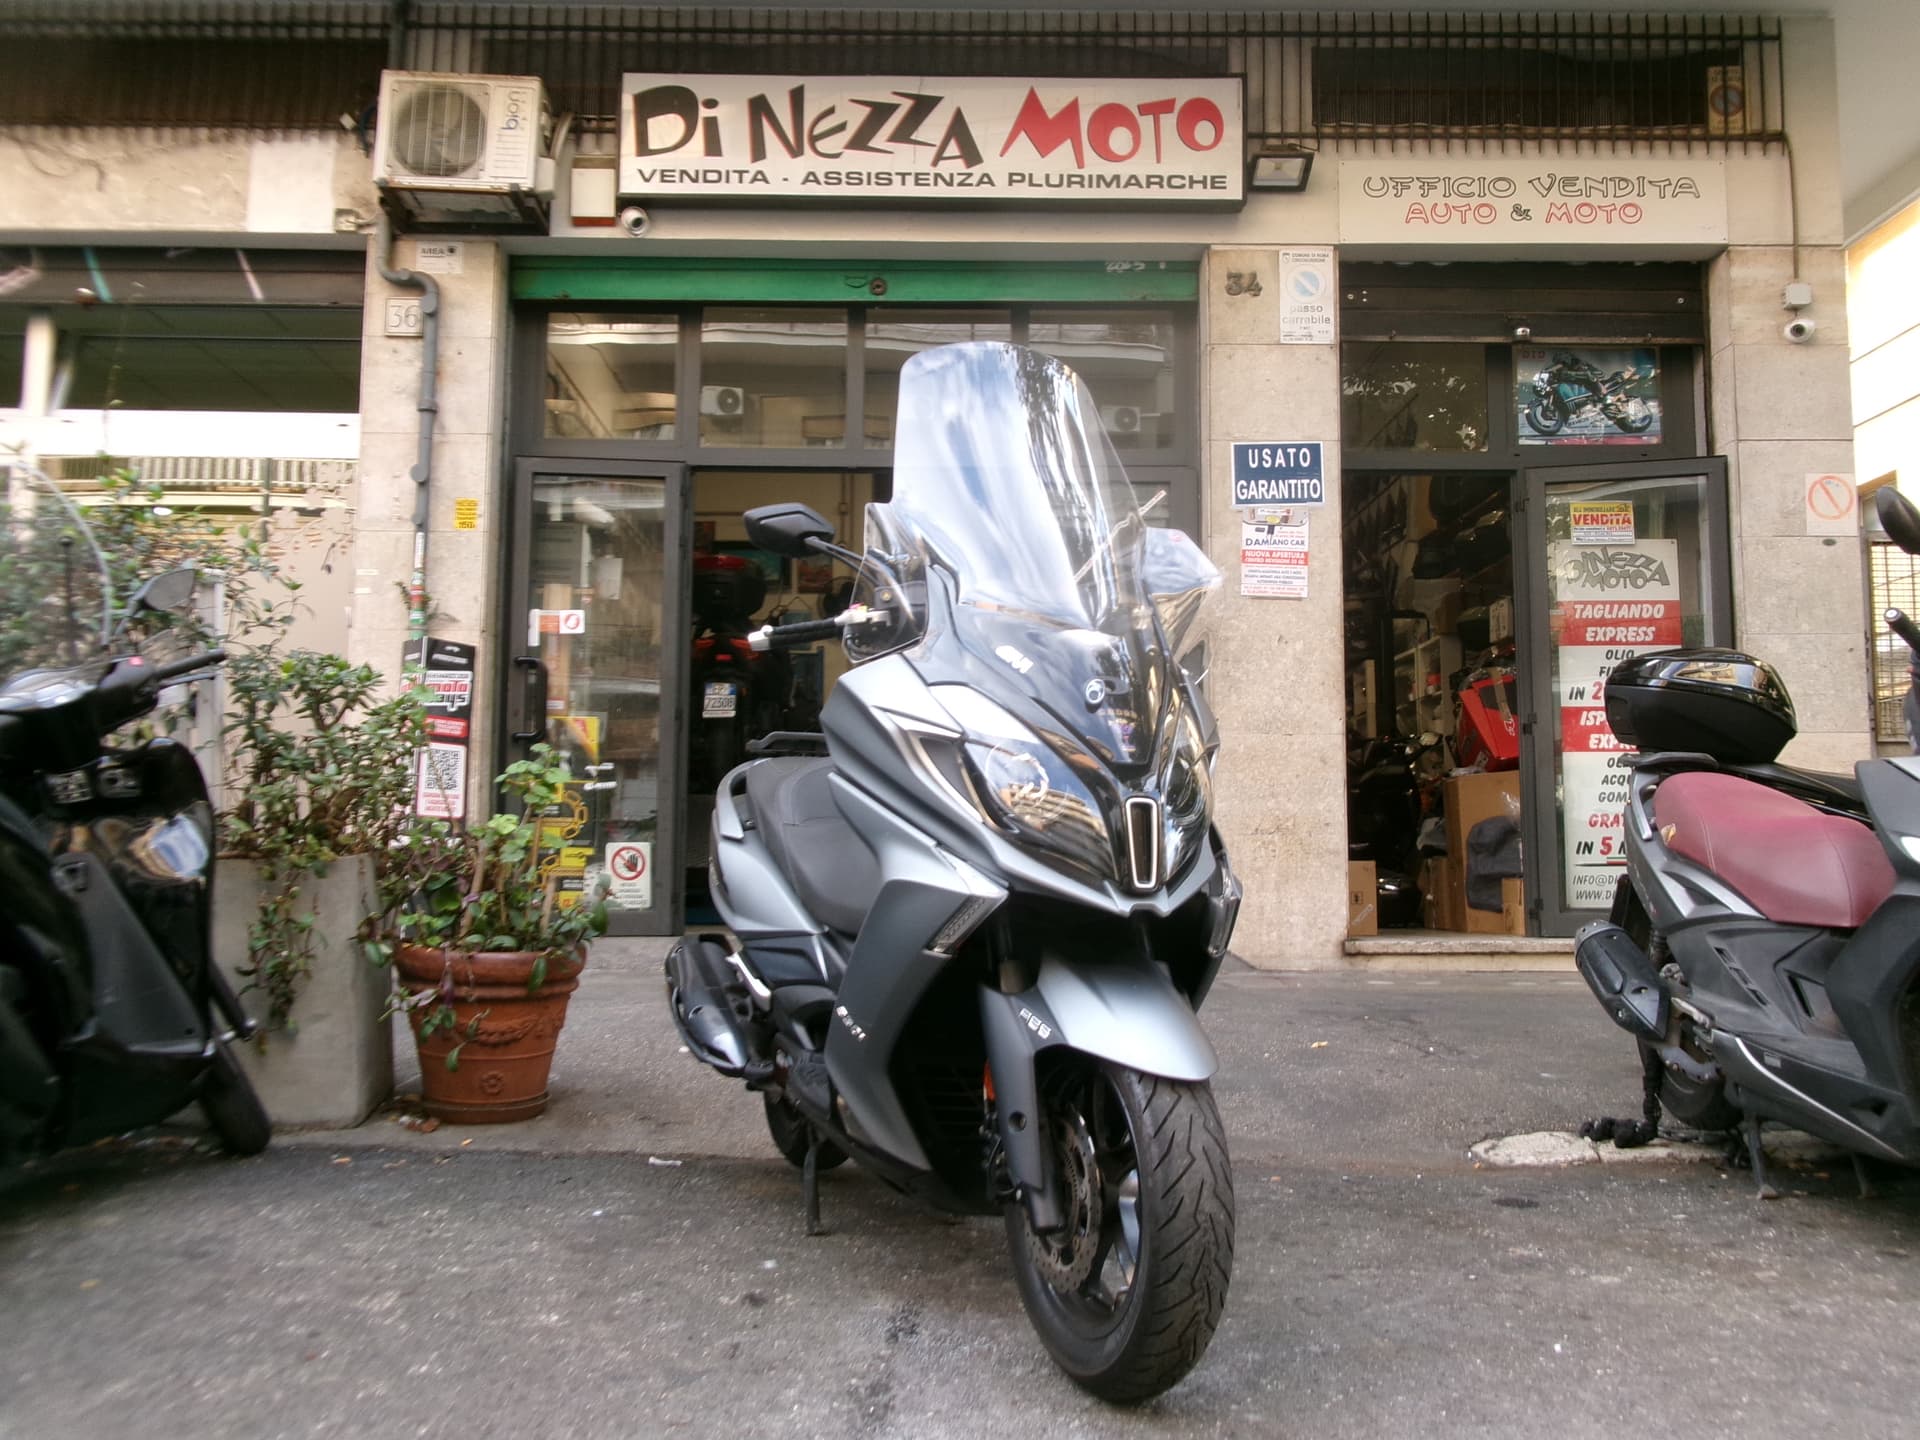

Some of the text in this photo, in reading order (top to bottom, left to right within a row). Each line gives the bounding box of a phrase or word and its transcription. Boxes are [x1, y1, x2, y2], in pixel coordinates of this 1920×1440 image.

[1000, 85, 1225, 169] MOTO
[637, 168, 770, 184] VENDITA
[801, 170, 996, 187] ASSISTENZA
[1007, 172, 1228, 190] PLURIMARCHE
[1363, 173, 1701, 199] UFFICIO VENDITA
[1405, 202, 1643, 224] AUTO & MOTO
[1224, 270, 1263, 297] 34
[389, 304, 418, 328] 36
[1291, 304, 1323, 315] passo
[1282, 315, 1331, 325] carrabile
[1248, 447, 1311, 468] USATO
[1236, 479, 1321, 500] GARANTITO
[1572, 513, 1632, 526] VENDITA
[1245, 538, 1289, 547] DAMIANO
[1245, 550, 1271, 558] NUOVA
[1581, 567, 1648, 593] MOTO
[1574, 604, 1664, 619] TAGLIANDO
[1585, 627, 1656, 642] EXPRESS
[1605, 649, 1635, 660] OLIO
[1568, 687, 1585, 700] IN
[1576, 841, 1594, 855] IN
[1600, 836, 1613, 855] 5
